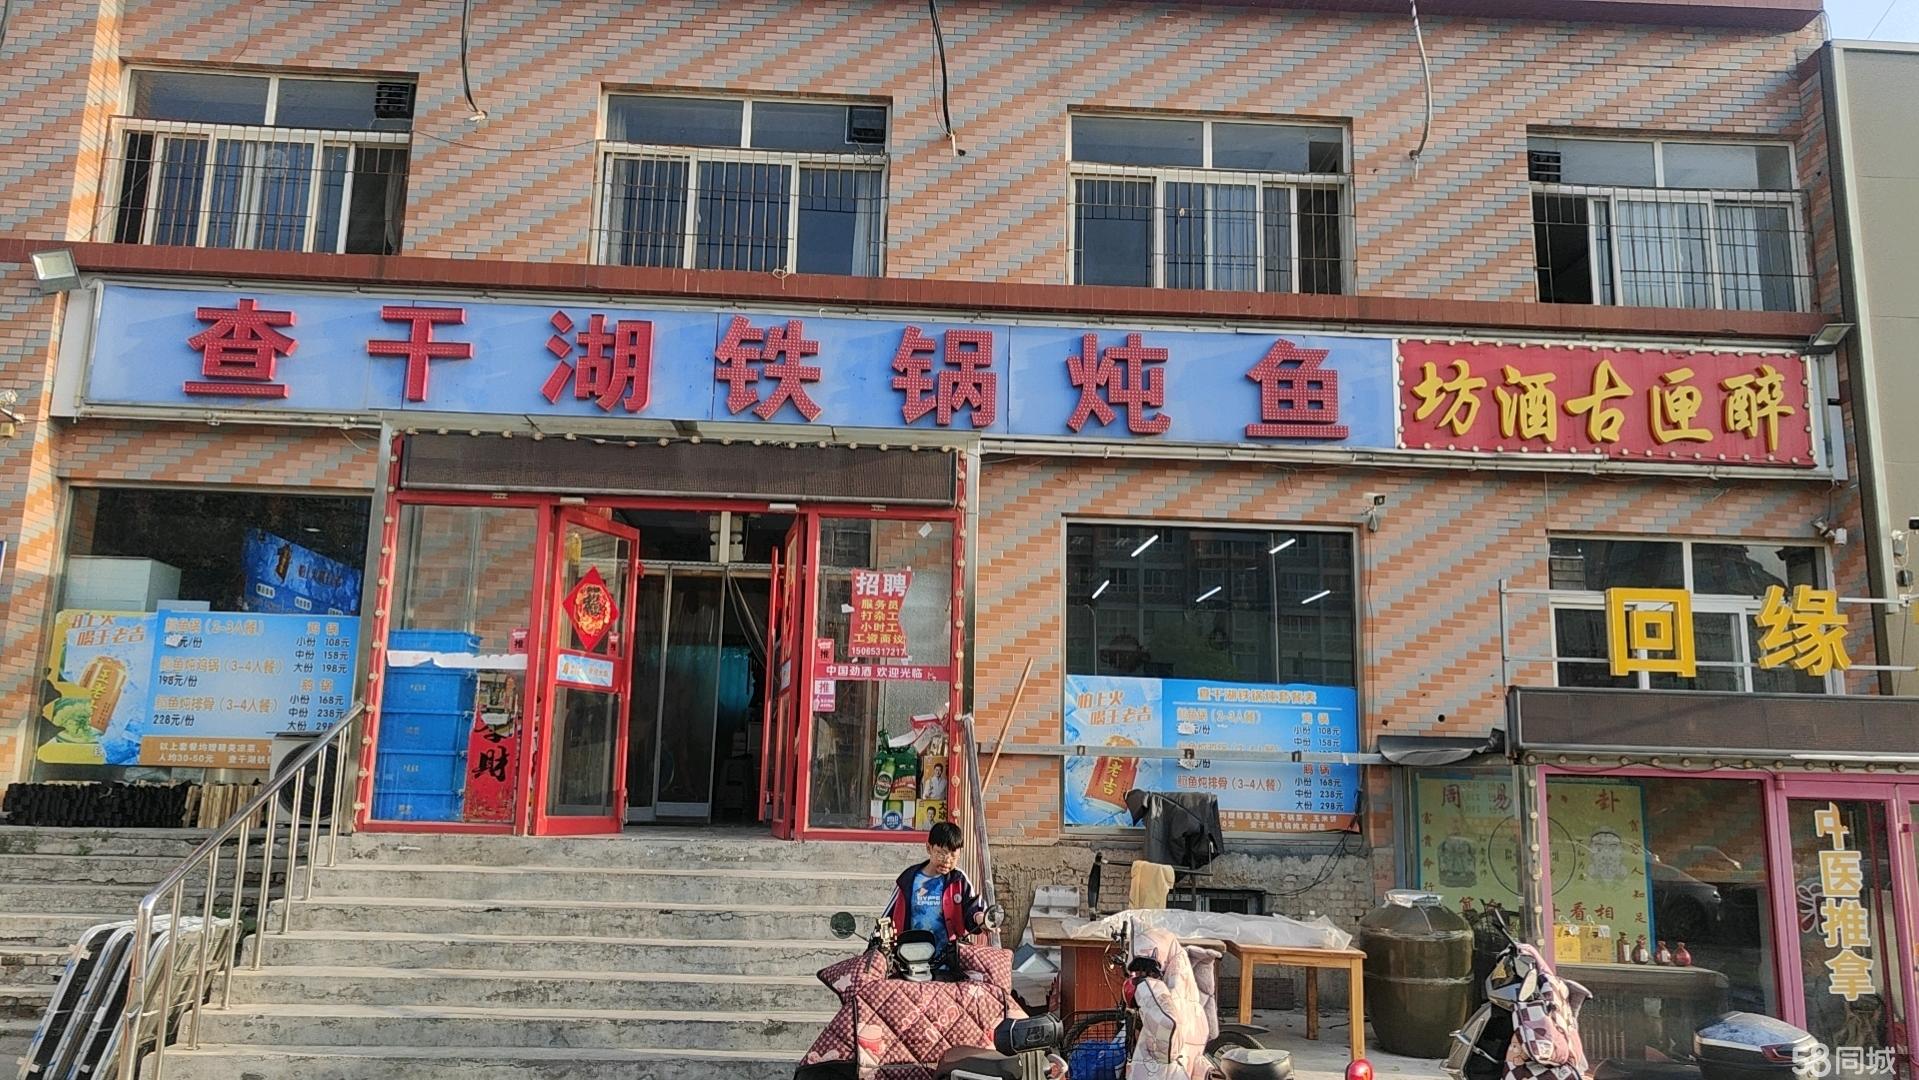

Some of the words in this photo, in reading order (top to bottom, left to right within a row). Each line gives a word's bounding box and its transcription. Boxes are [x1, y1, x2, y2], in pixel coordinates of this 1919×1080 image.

[182, 298, 1350, 440] 查干湖铁锅炖鱼
[856, 572, 907, 596] 招聘
[861, 598, 899, 610] 服务员
[861, 610, 899, 622] 打杂工
[860, 622, 898, 633] 小时工
[1605, 584, 1853, 677] 回缘
[76, 625, 144, 646] 喝王老吉
[853, 632, 905, 644] 工资面议
[296, 637, 316, 647] 小份
[325, 638, 350, 648] 108元
[295, 649, 315, 660] 中份
[324, 649, 349, 661] 158元
[293, 662, 313, 673] 大份
[322, 662, 348, 674] 198元
[826, 664, 872, 677] 中国劲酒
[876, 666, 923, 679] 欢迎光临
[290, 694, 310, 705] 小份
[319, 695, 344, 706] 168元
[1078, 690, 1123, 709] 怕上火
[288, 707, 308, 718] 中份
[317, 708, 344, 719] 238元
[1090, 705, 1152, 725] 喝王老吉
[153, 713, 194, 727] 228元/份
[287, 721, 307, 731] 大份
[1294, 725, 1311, 735] 小份
[1319, 727, 1341, 736] 108元
[1294, 738, 1311, 748] 中份
[1319, 738, 1341, 748] 158元
[1295, 778, 1312, 788] 小份
[1320, 778, 1342, 788] 168元
[1295, 790, 1312, 800] 中份
[1320, 791, 1344, 800] 238元
[1296, 802, 1313, 811] 大份
[1320, 803, 1344, 812] 298元
[1814, 801, 1876, 1002] 中医推拿
